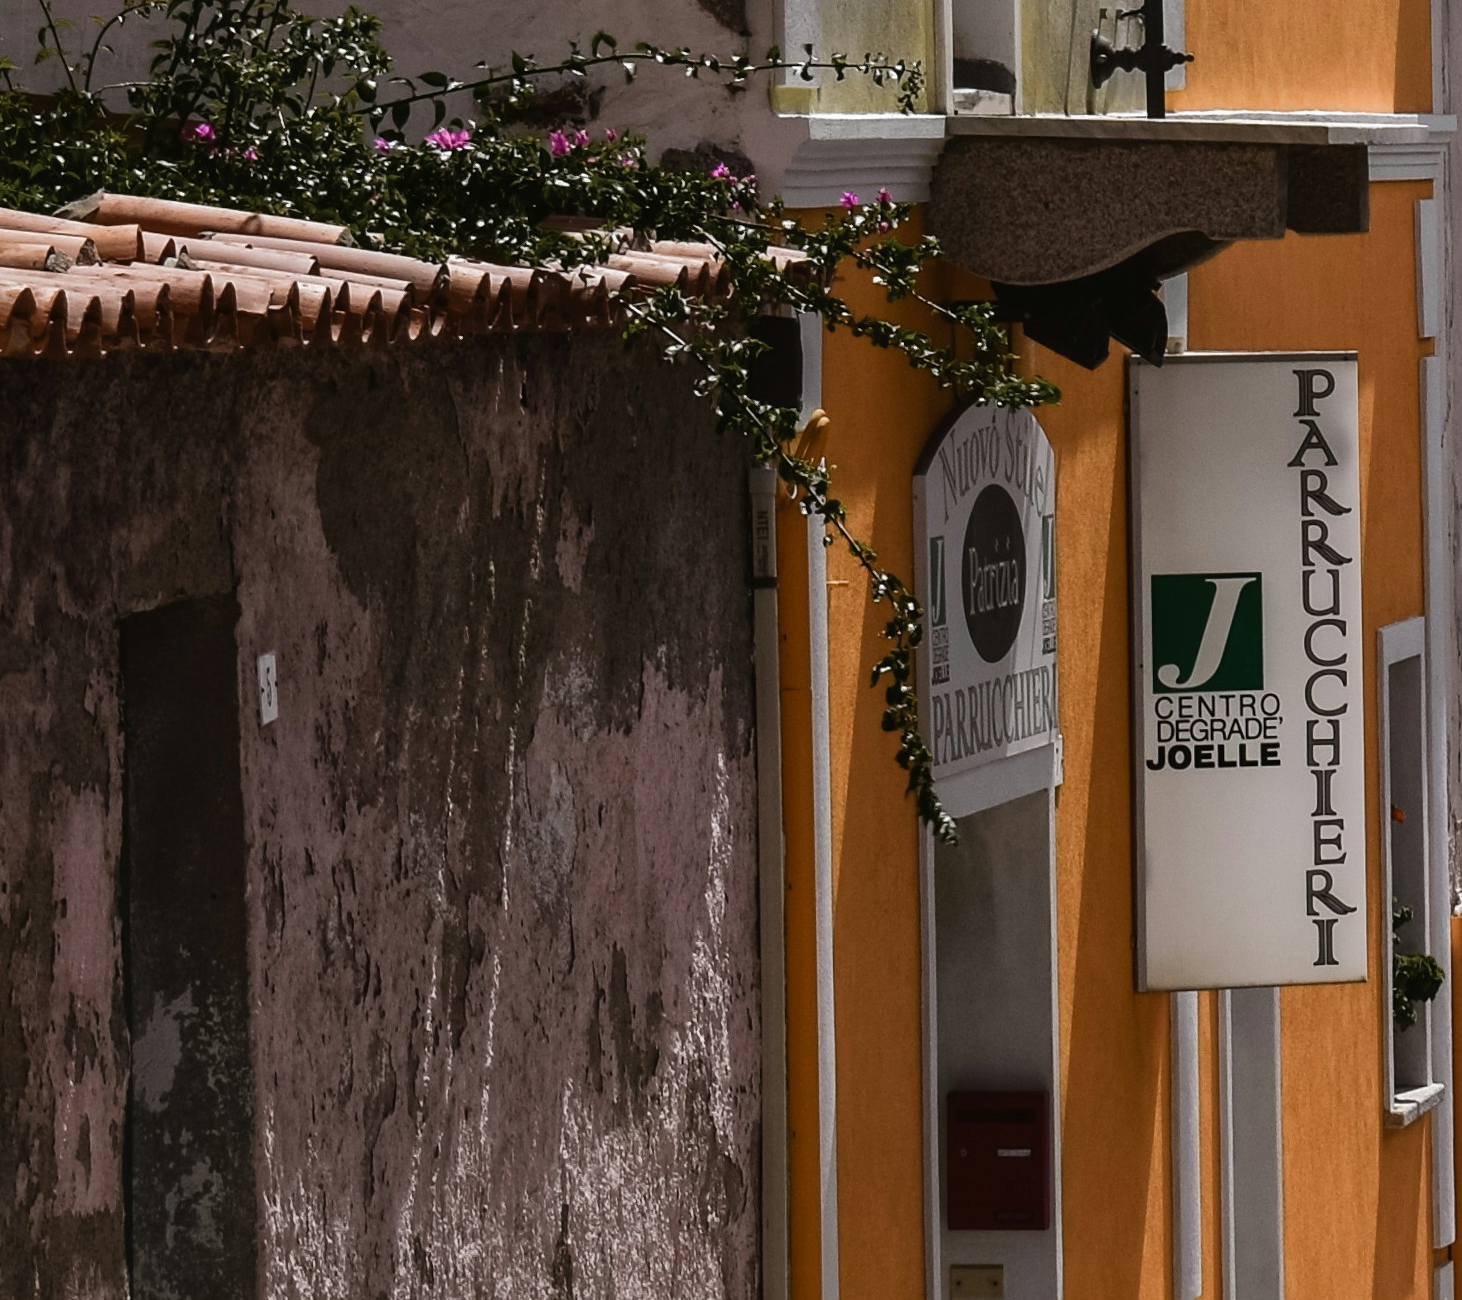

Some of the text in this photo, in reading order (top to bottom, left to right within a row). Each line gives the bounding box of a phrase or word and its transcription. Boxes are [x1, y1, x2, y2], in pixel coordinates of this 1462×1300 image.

[968, 534, 1021, 616] Patrizia
[1157, 576, 1258, 691] J
[1287, 368, 1358, 967] PARRUCCHIERI
[931, 662, 1058, 767] PARRUCCHIERI
[1154, 693, 1282, 721] CENTRO
[1156, 715, 1284, 744] DEGRADE'
[1145, 741, 1282, 772] JOELLE
